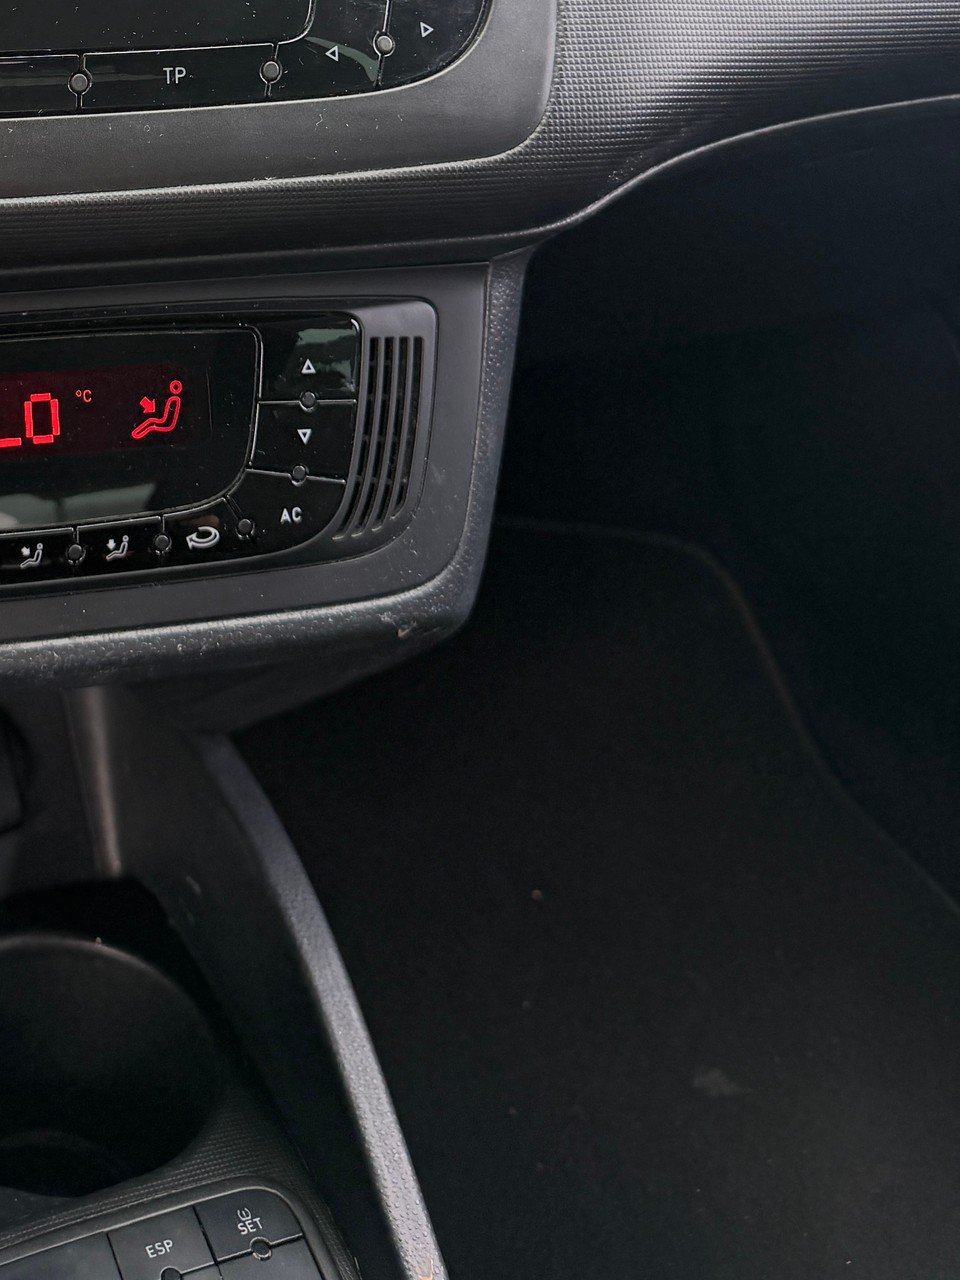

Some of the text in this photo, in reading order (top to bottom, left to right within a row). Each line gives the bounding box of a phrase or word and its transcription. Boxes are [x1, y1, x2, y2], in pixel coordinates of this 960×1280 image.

[163, 67, 187, 84] TP
[280, 507, 303, 524] AC
[237, 1217, 263, 1235] SET
[145, 1239, 174, 1259] ESP
